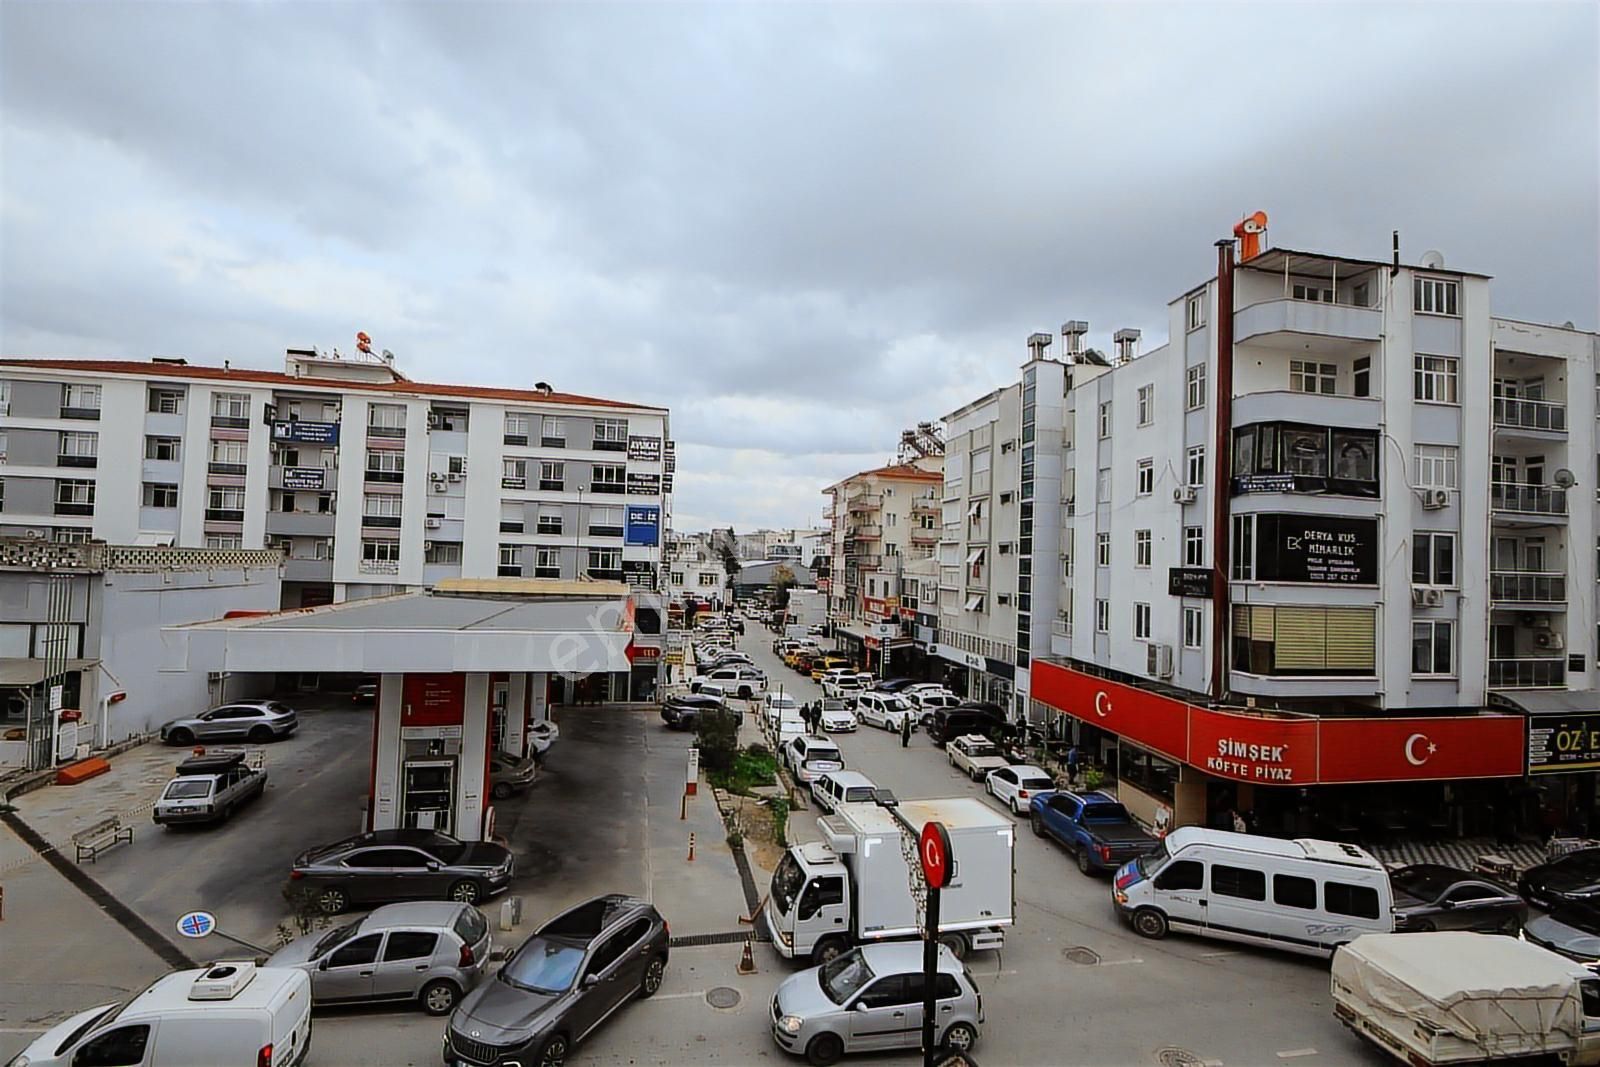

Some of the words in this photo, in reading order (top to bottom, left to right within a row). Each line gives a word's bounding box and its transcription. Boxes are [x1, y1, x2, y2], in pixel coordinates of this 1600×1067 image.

[1304, 530, 1333, 541] DERYA
[1557, 724, 1581, 752] ÖZ
[1218, 738, 1283, 762] ŞİMŞEK
[1207, 757, 1248, 776] KÖFTE
[1256, 764, 1293, 780] PİYAZ
